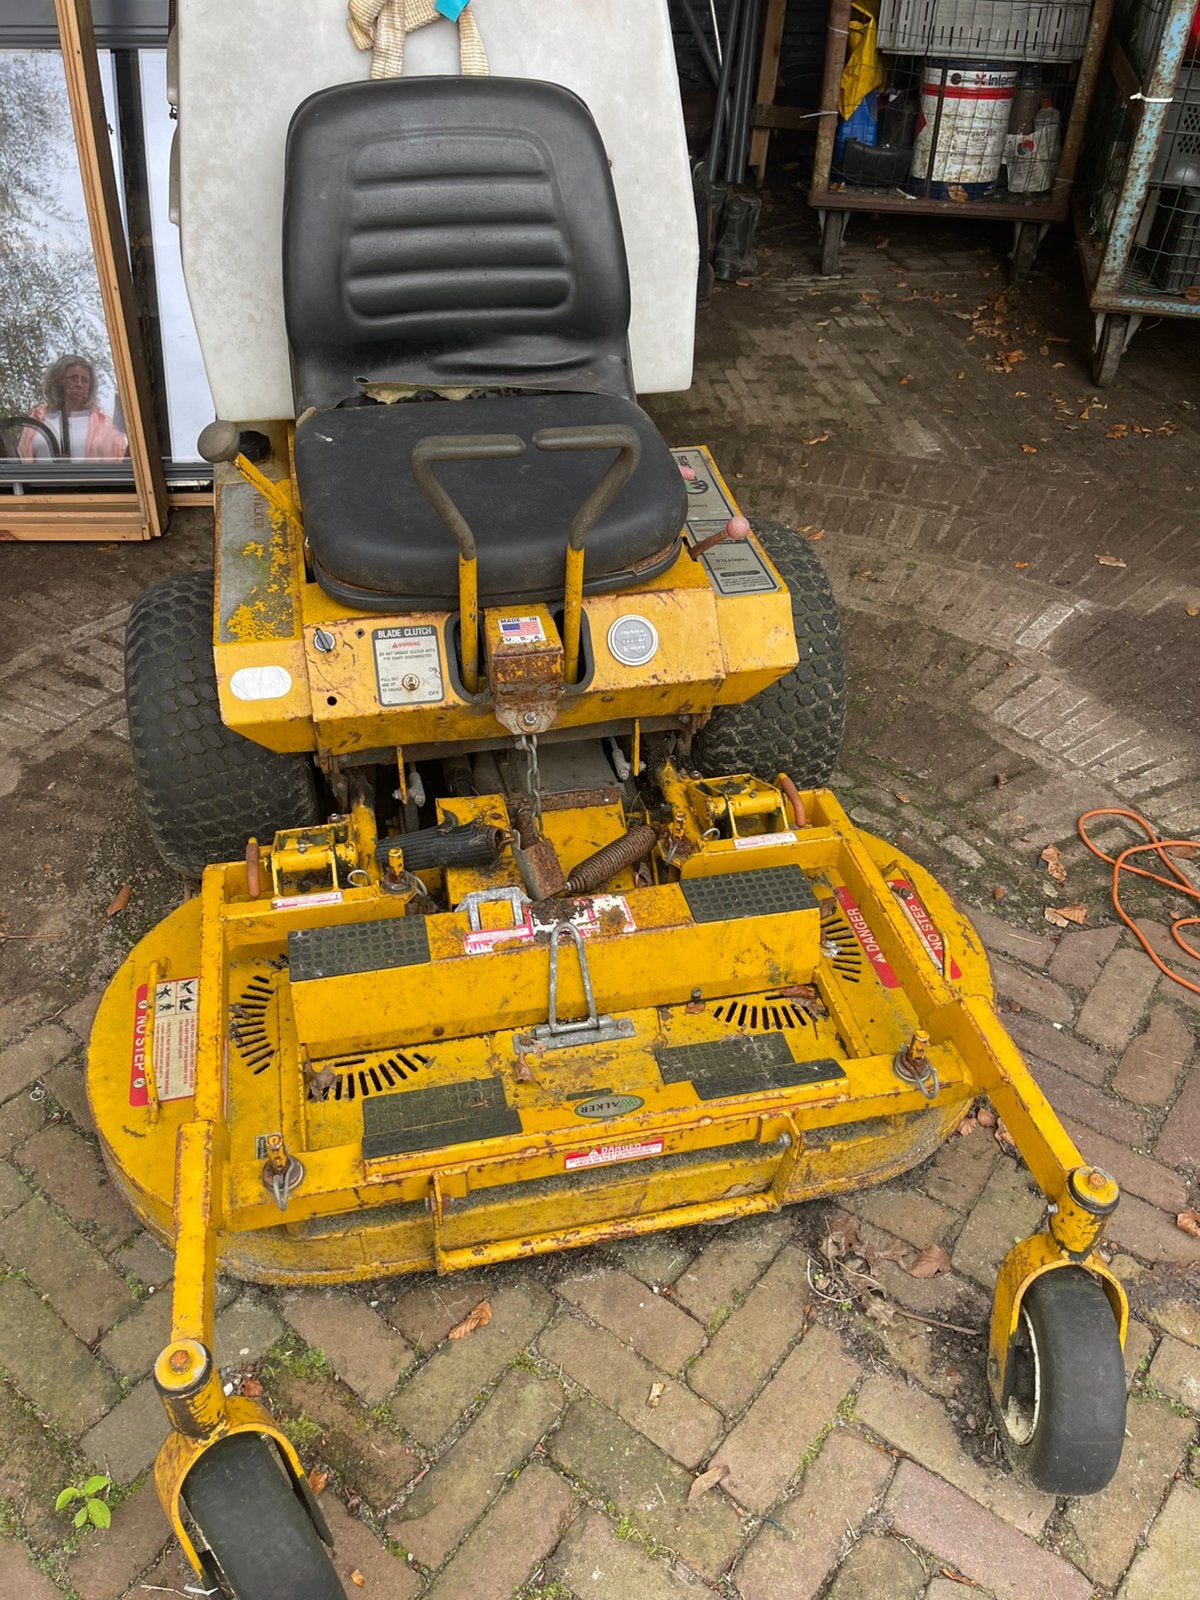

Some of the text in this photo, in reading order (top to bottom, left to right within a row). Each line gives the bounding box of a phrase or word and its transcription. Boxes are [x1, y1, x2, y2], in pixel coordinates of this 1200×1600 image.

[378, 627, 432, 639] BLADE CLUTCH
[847, 908, 880, 952] DANGER
[909, 903, 943, 951] NO STEP
[134, 1015, 147, 1071] NO STEP
[580, 1098, 638, 1113] WALKER
